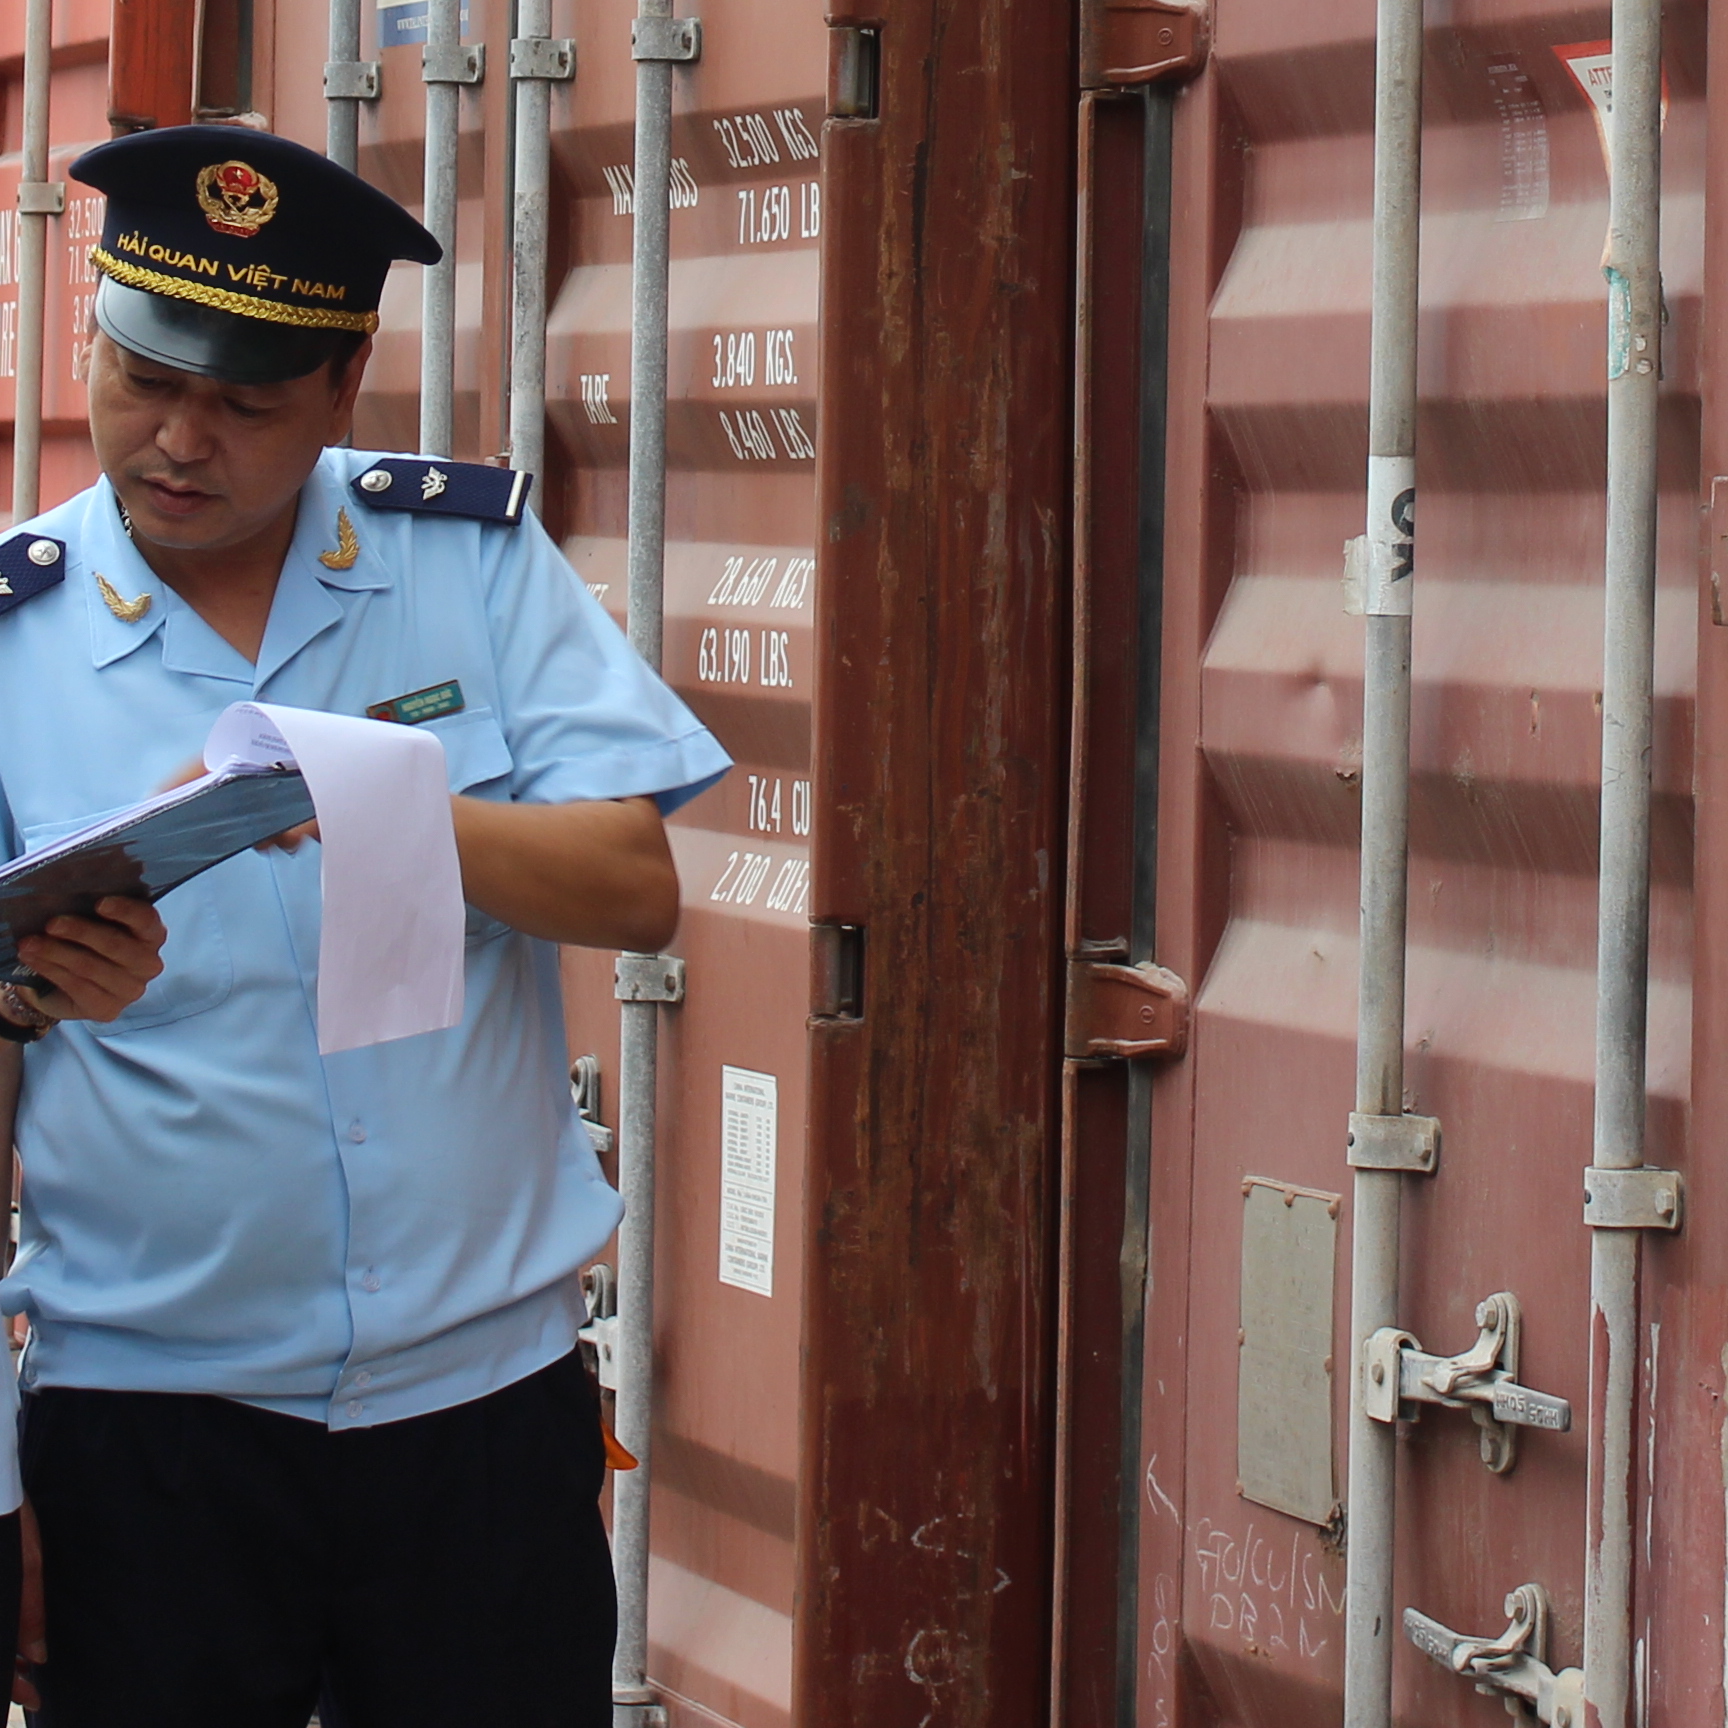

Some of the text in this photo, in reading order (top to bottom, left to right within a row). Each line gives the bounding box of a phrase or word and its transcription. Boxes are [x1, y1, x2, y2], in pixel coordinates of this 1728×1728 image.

[711, 113, 779, 169] 32,500
[738, 189, 791, 244] 71,650
[149, 244, 220, 276] QUAN
[292, 279, 346, 300] NAM
[711, 328, 797, 388] 3,840 KGS.
[580, 373, 618, 425] TARE
[747, 774, 782, 835] 76.4
